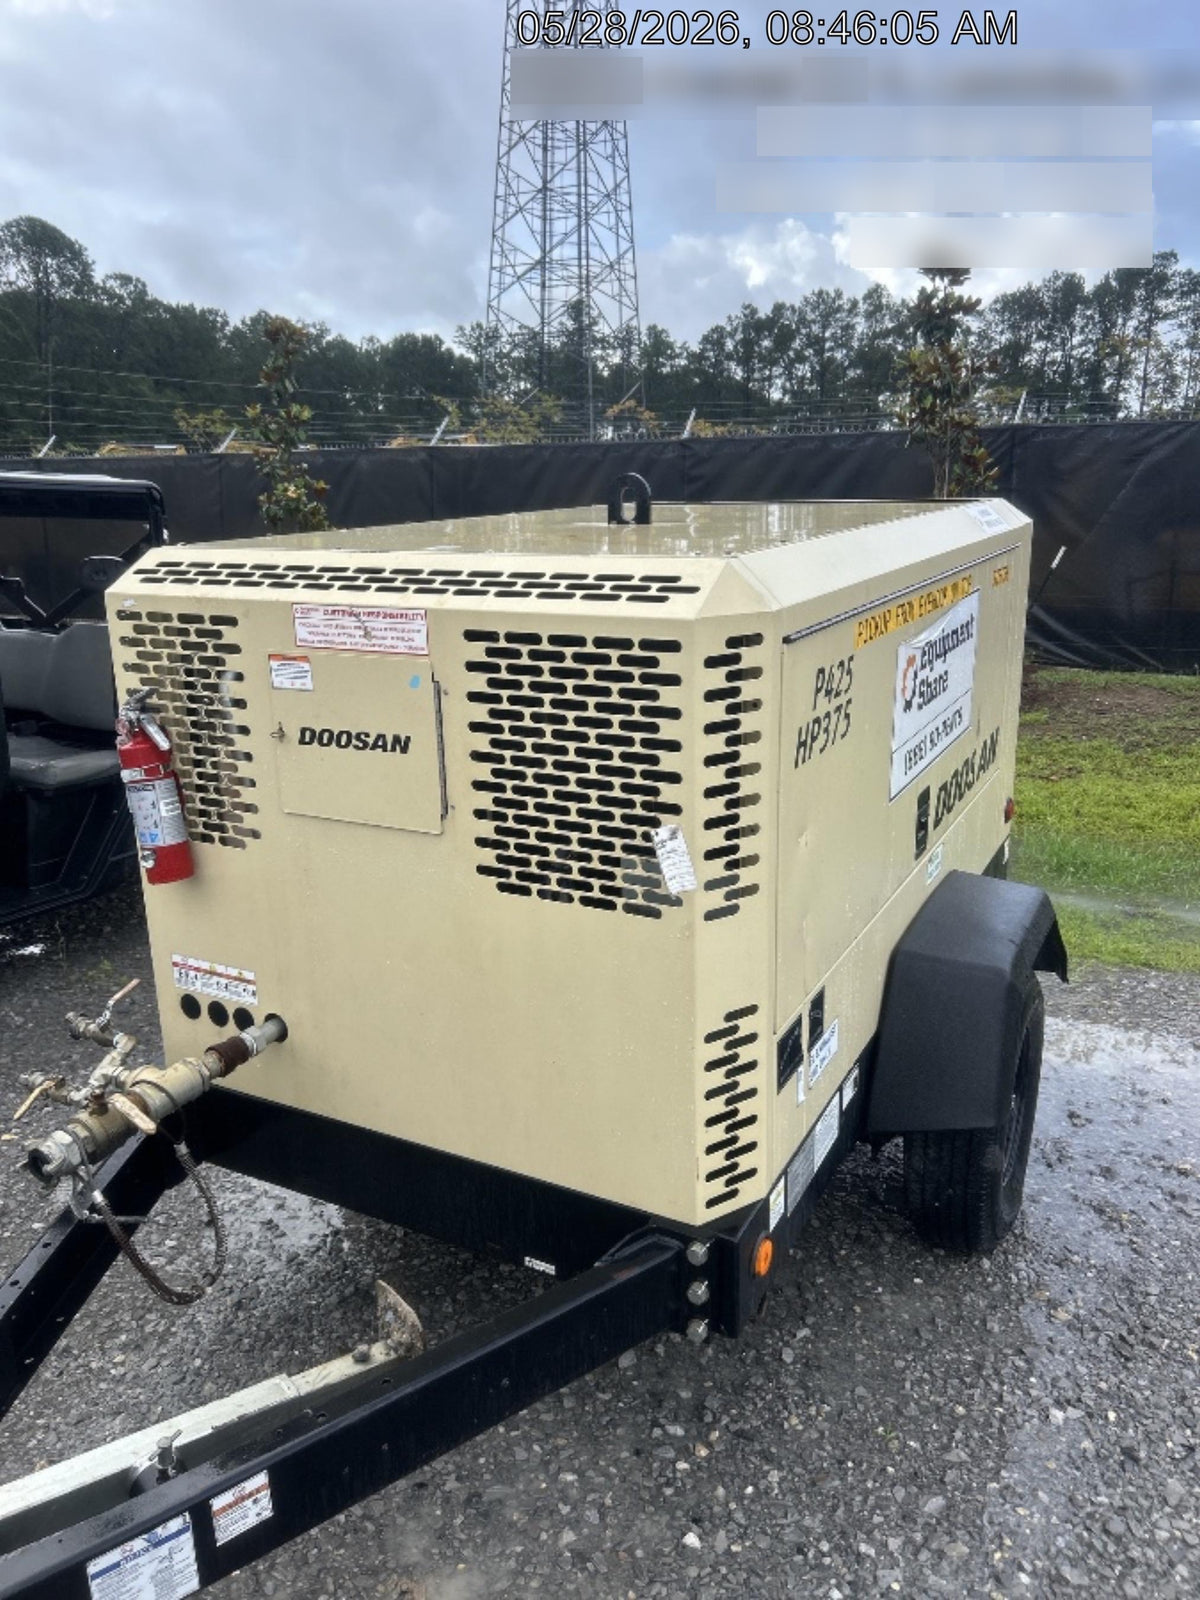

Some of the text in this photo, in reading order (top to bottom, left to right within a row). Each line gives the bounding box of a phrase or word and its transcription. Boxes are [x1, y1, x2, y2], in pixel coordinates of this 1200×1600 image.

[812, 654, 854, 711] P425
[298, 727, 411, 754] DOOSAN
[794, 698, 852, 769] HP375
[933, 725, 999, 830] DOOSAN
